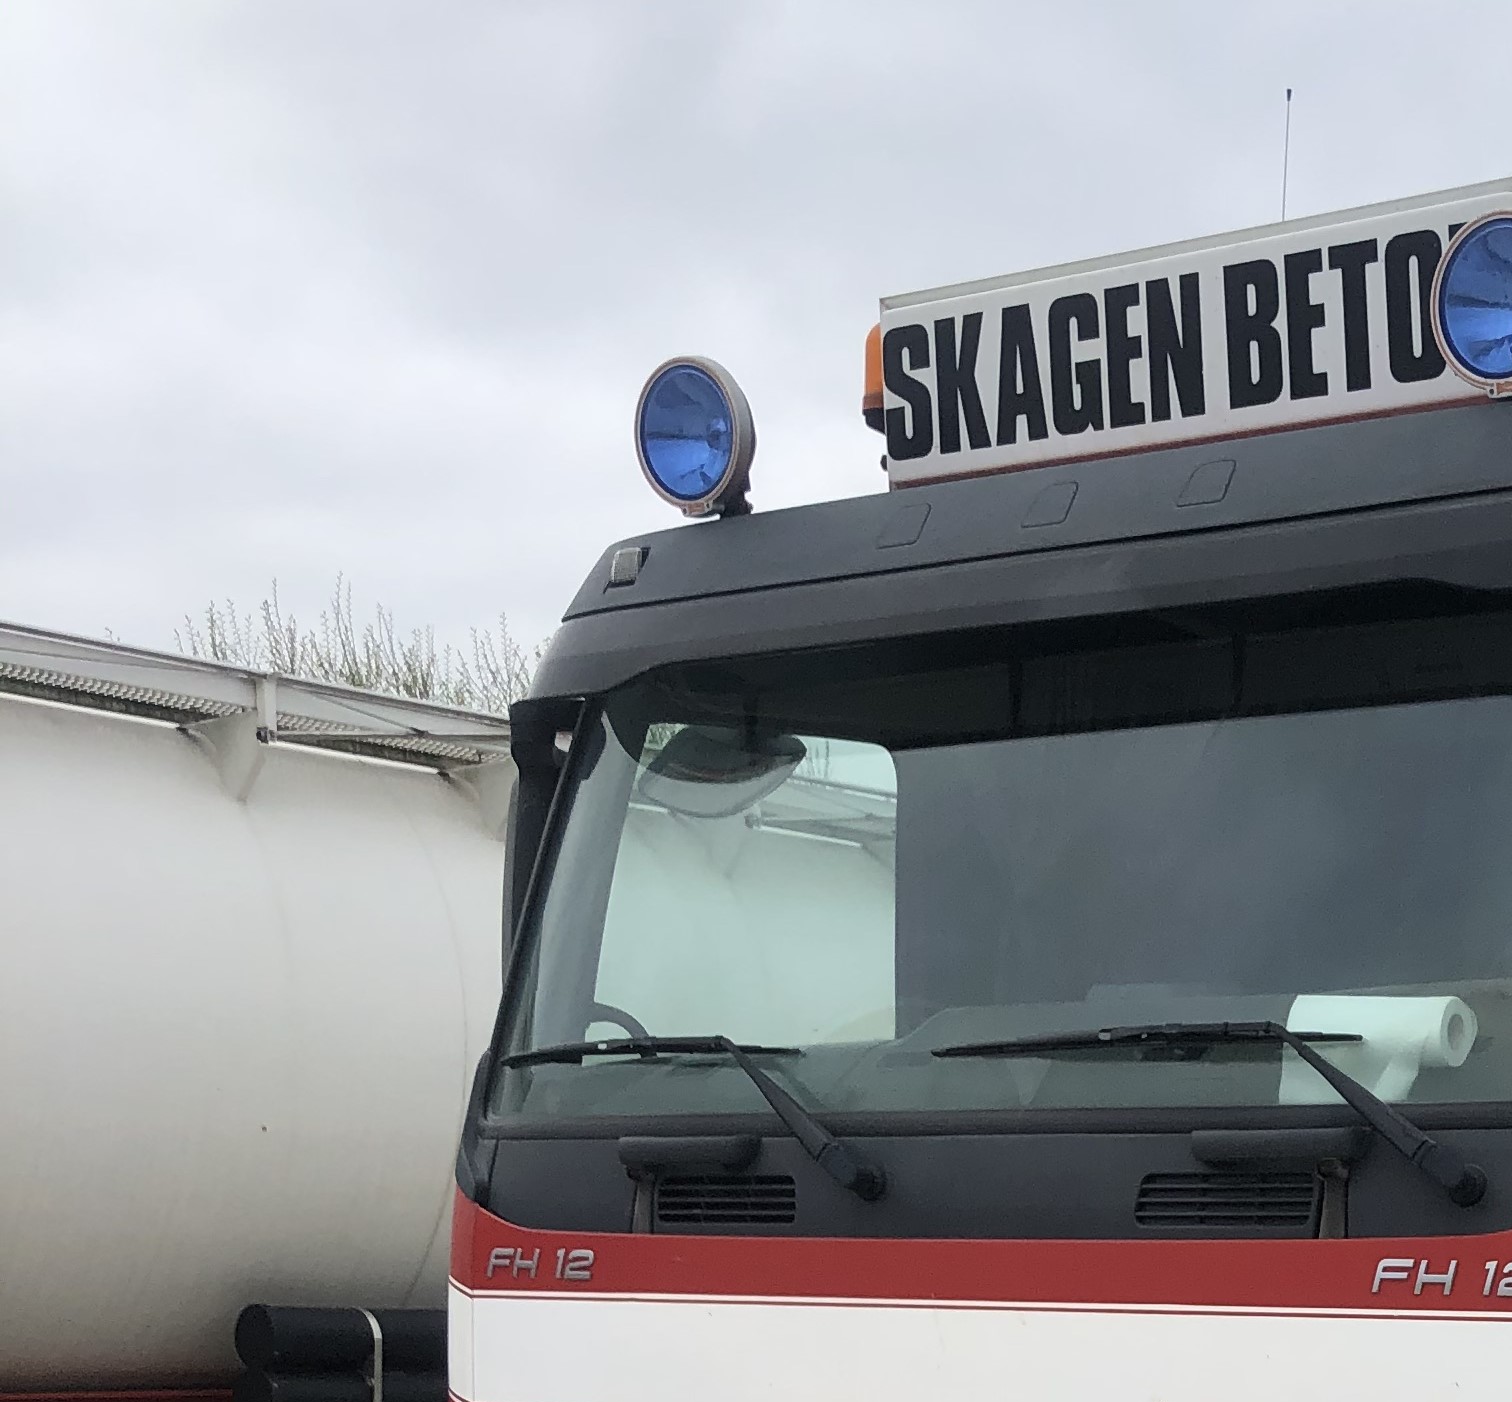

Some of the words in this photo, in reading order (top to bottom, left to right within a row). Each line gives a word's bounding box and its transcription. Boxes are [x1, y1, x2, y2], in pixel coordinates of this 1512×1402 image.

[883, 271, 1204, 461] SKAGEN
[1225, 221, 1468, 411] BETO
[486, 1247, 541, 1279] FH
[555, 1248, 595, 1280] 12
[1371, 1258, 1458, 1296] FH
